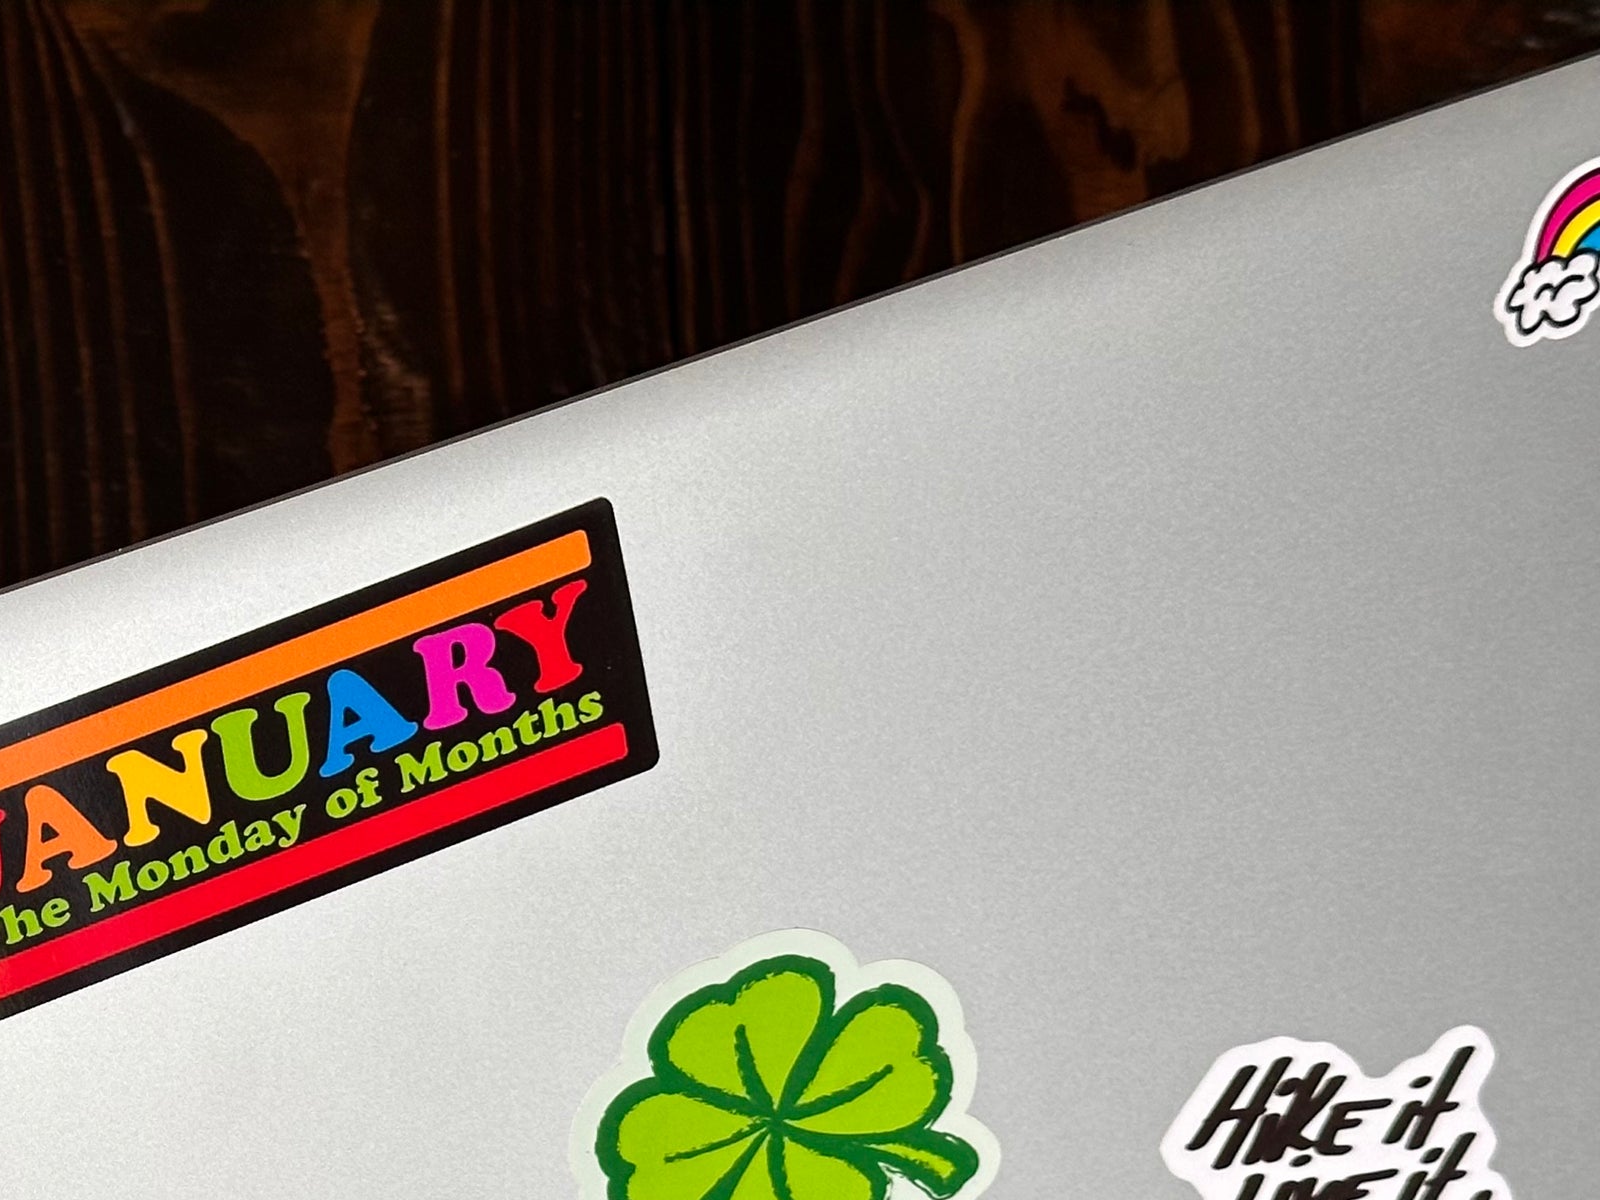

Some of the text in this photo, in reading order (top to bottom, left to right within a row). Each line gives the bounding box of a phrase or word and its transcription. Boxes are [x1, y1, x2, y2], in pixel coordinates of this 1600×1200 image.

[82, 803, 306, 914] Monday
[325, 767, 381, 819] of
[398, 689, 605, 795] Months
[1381, 1046, 1475, 1151] it
